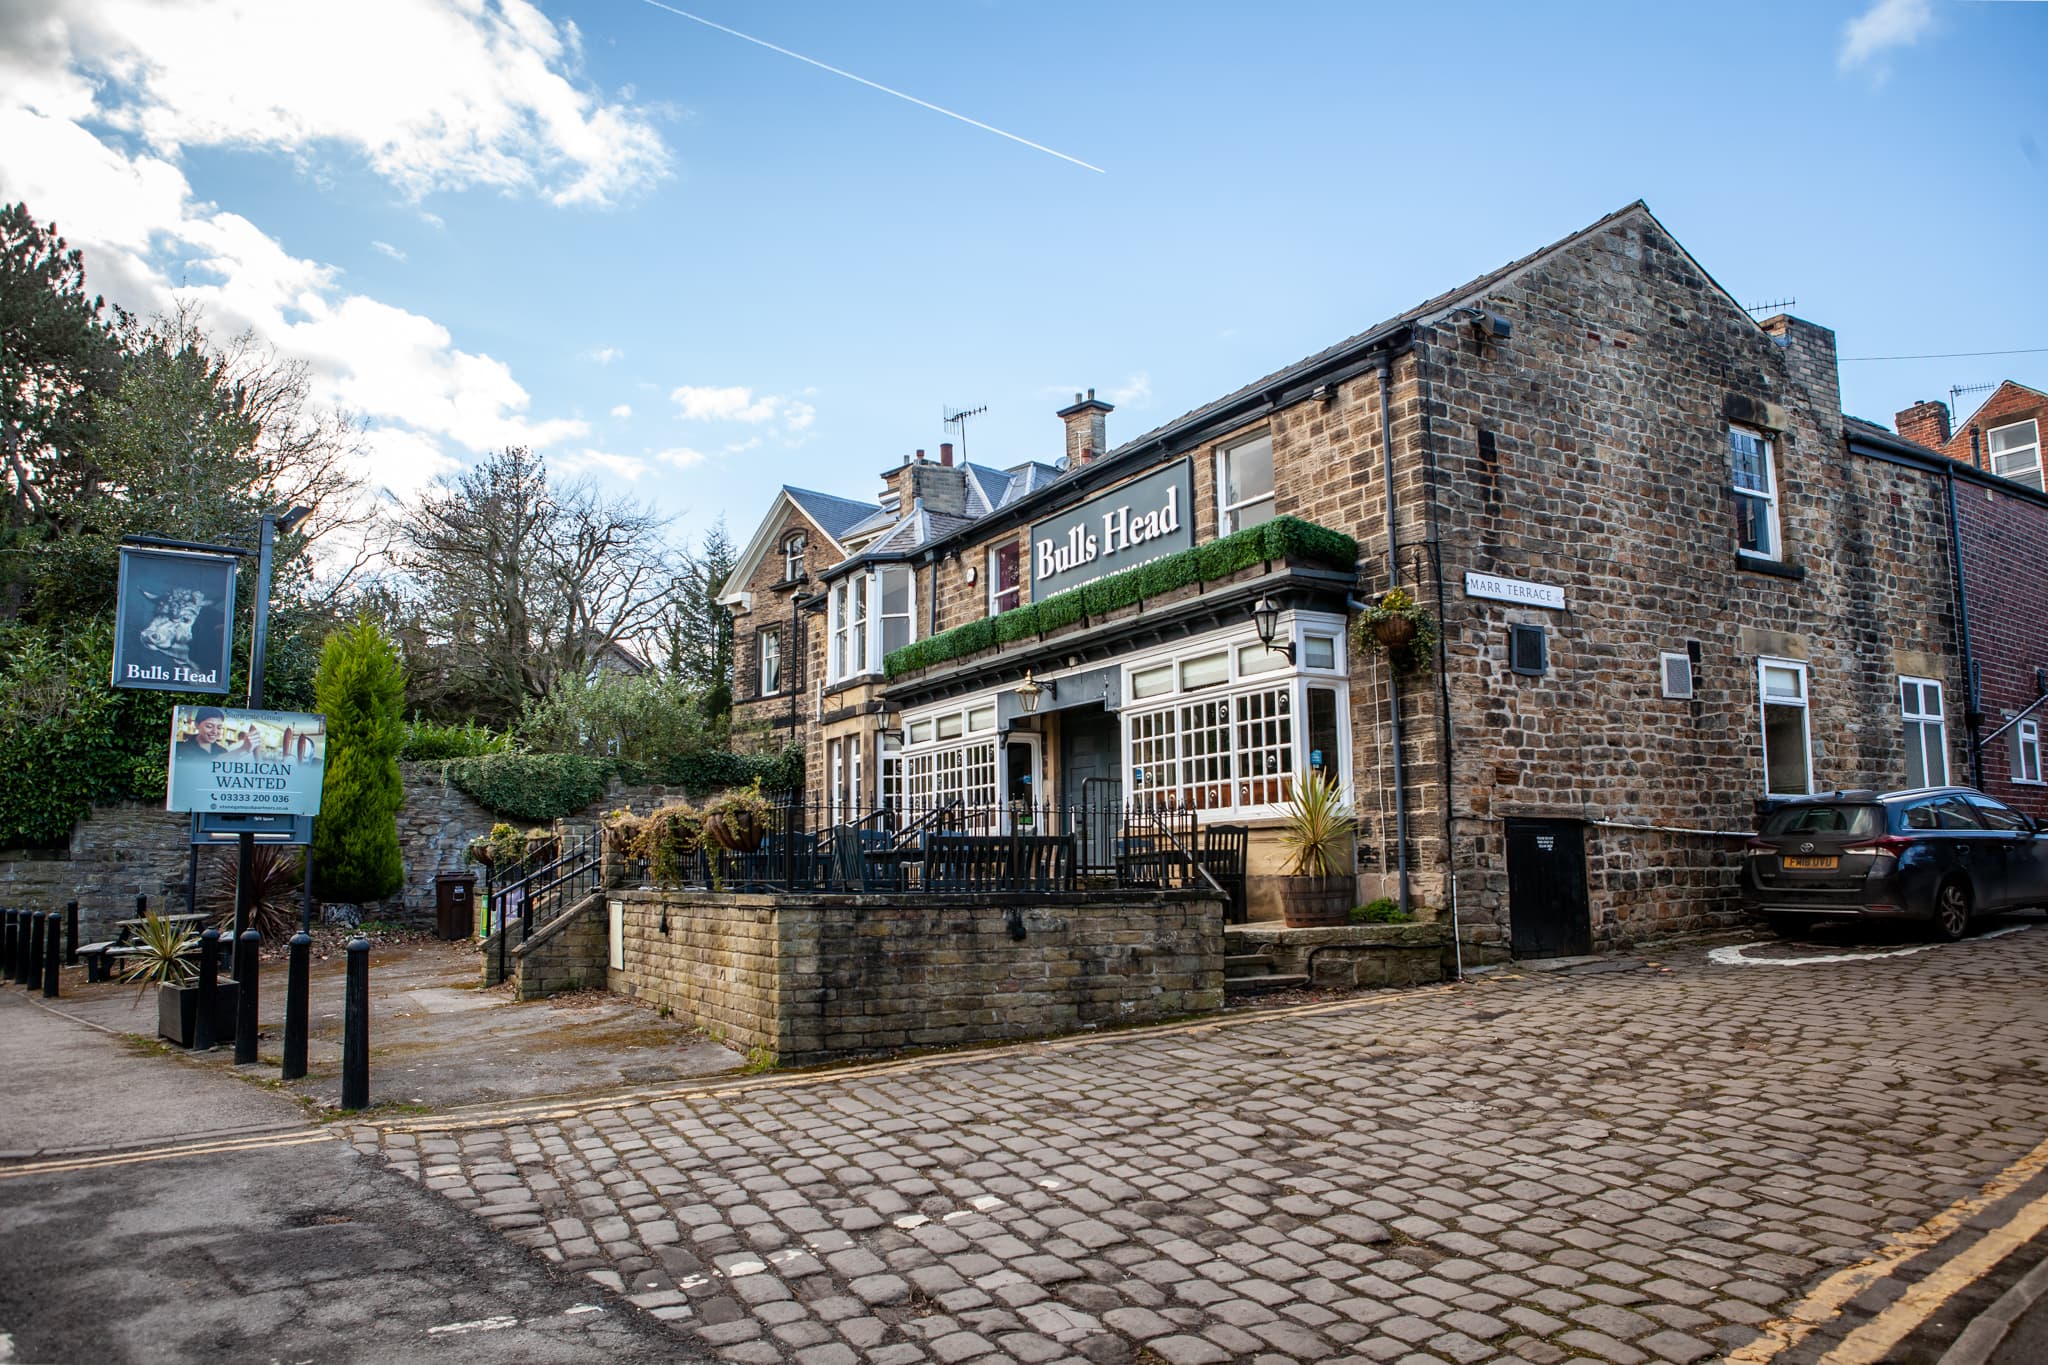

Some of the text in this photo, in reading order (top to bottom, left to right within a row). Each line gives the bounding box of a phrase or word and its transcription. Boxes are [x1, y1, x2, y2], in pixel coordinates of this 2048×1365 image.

[1036, 485, 1180, 580] Bulls Head
[1470, 578, 1552, 601] MARR TERRACE
[127, 663, 217, 684] Bulls Head
[211, 761, 292, 776] PUBLICAN
[216, 776, 287, 790] WANTED
[220, 793, 289, 803] 03333 200 036
